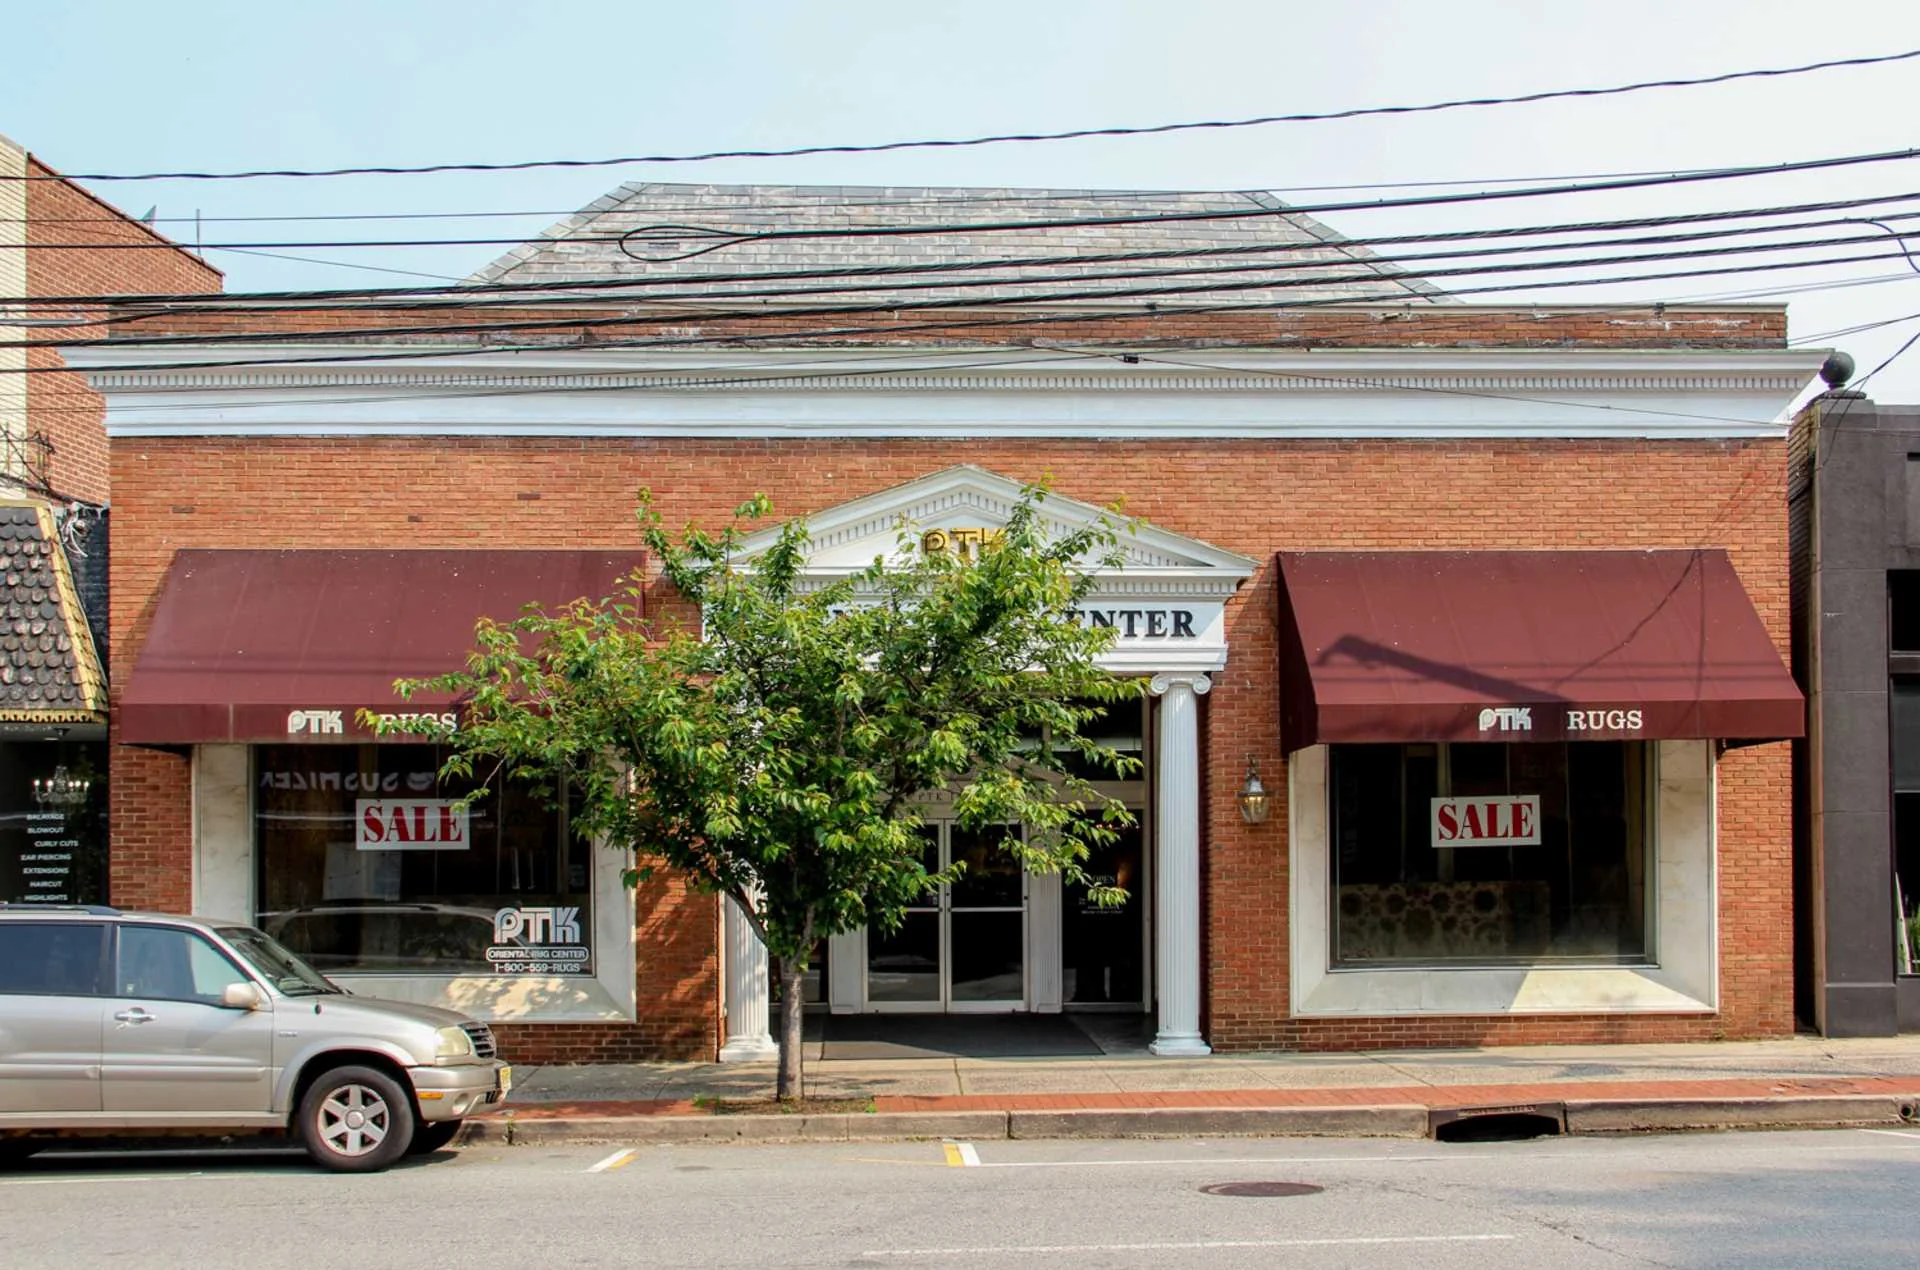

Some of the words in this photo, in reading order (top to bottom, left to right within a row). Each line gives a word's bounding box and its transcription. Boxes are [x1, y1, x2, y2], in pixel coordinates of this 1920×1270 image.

[288, 710, 343, 734] PTK
[1479, 707, 1532, 731] PTK
[1567, 710, 1642, 730] RUGS
[27, 826, 65, 834] BLOWOUT
[363, 806, 463, 843] SALE
[1438, 803, 1534, 840] SALE
[34, 840, 58, 848] CURLY
[23, 867, 70, 875] EXTENSIONS
[494, 907, 581, 944] PTK
[551, 950, 585, 959] CENTER
